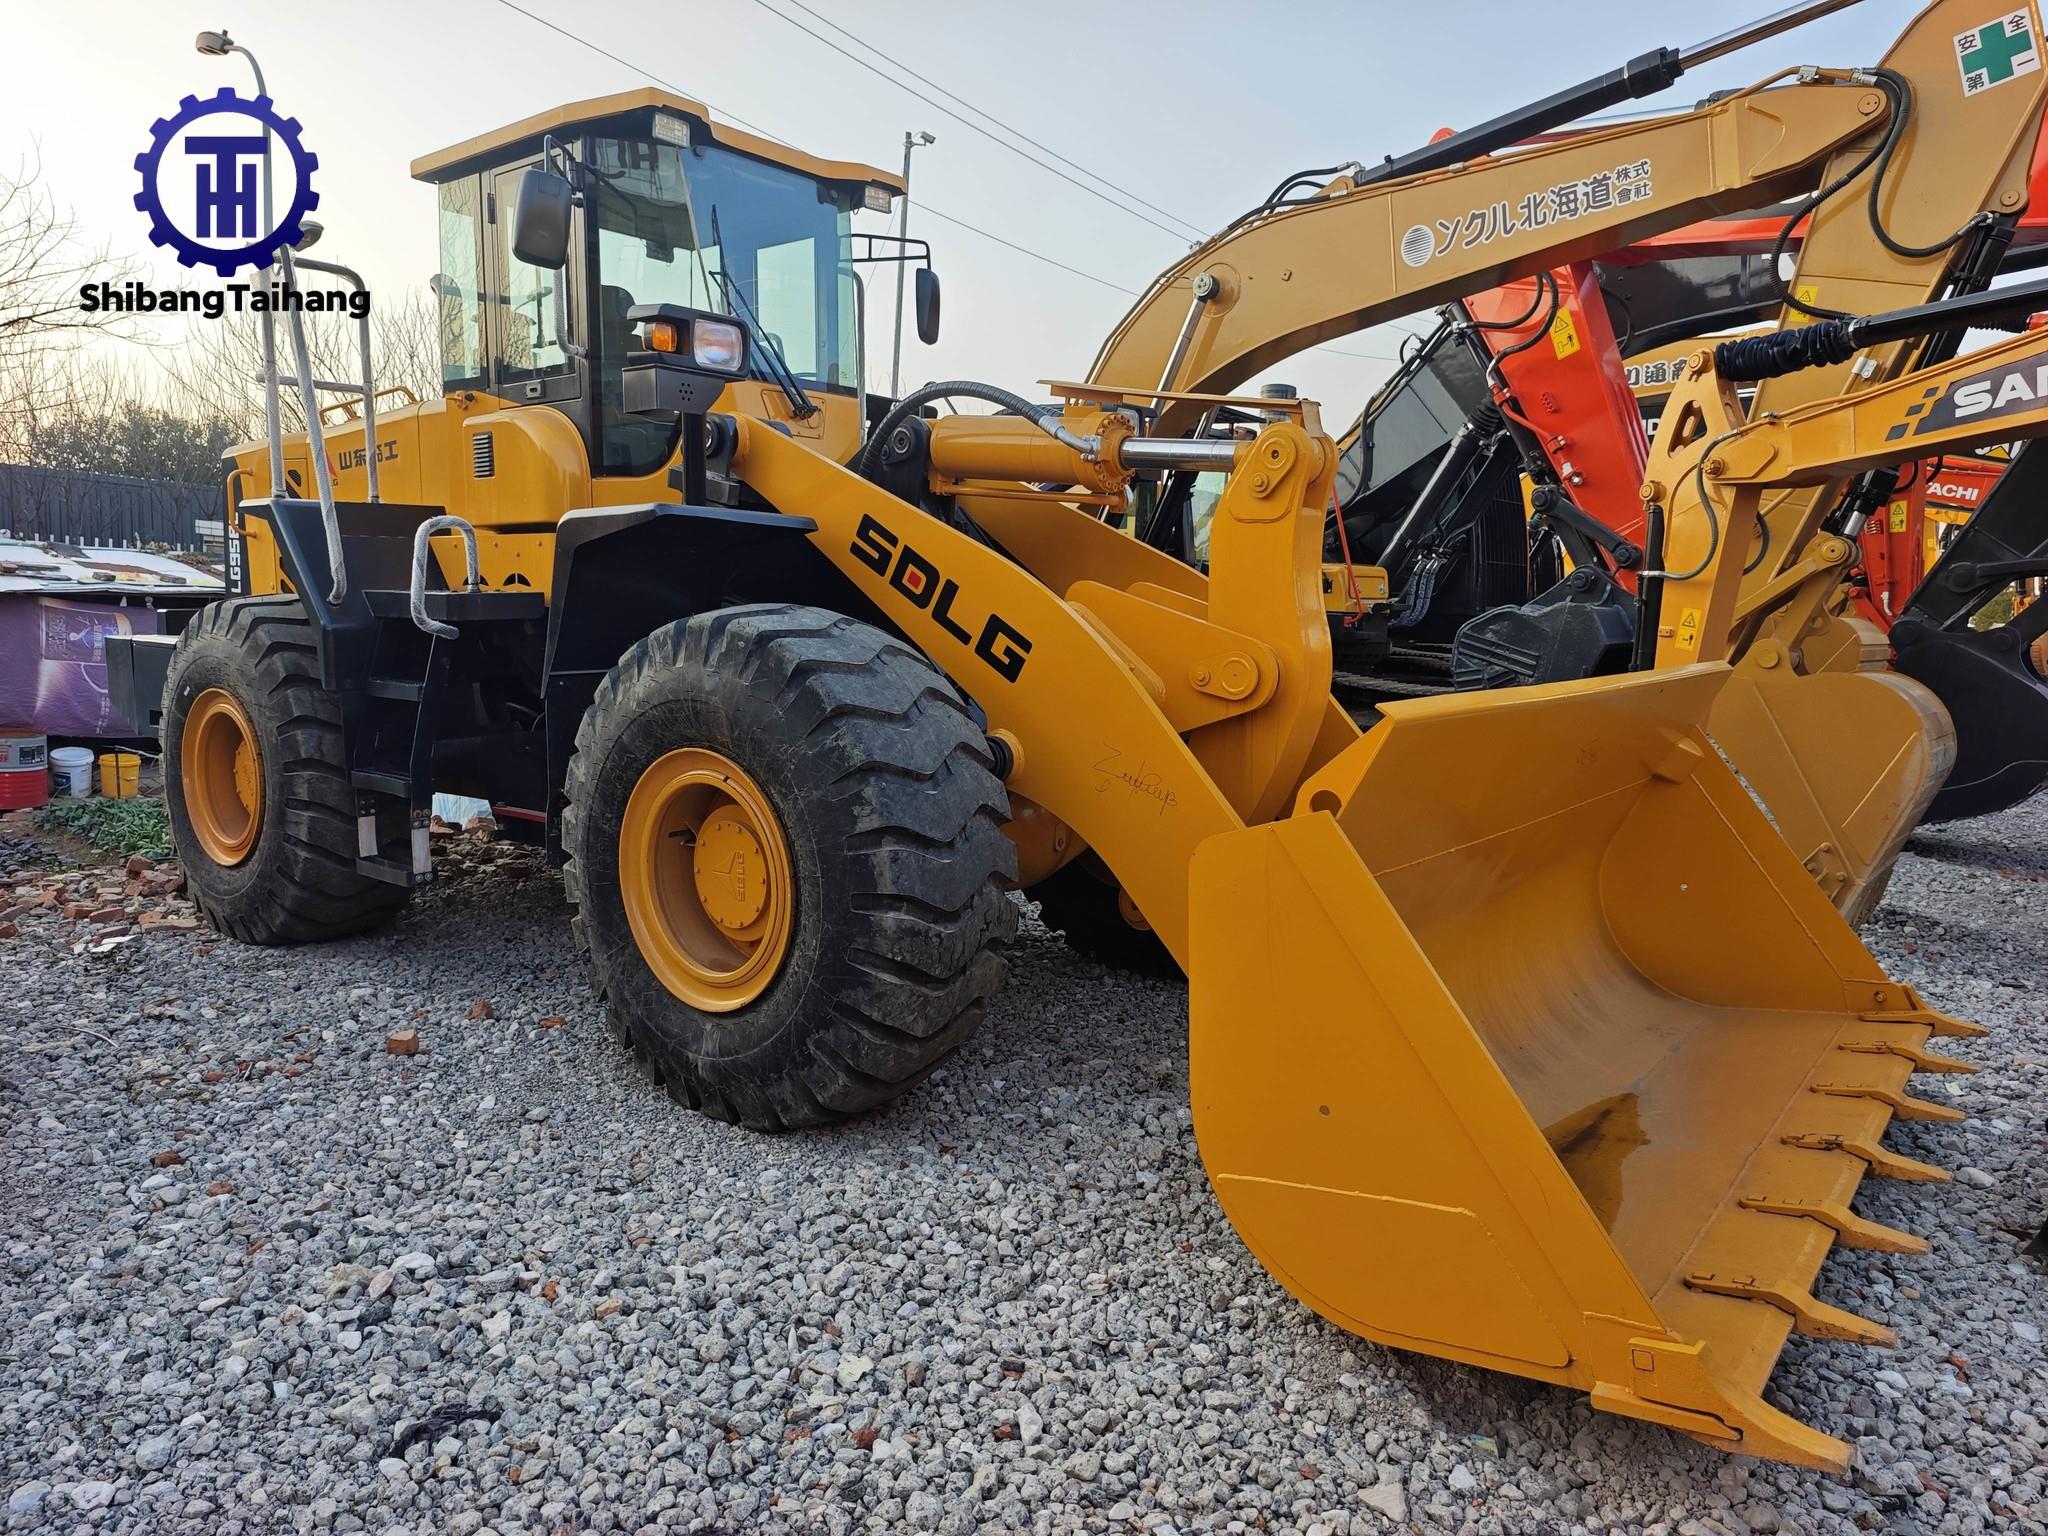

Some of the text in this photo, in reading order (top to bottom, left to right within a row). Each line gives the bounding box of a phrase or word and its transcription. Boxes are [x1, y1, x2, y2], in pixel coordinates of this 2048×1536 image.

[1957, 14, 2027, 54] 安 全
[1615, 160, 1651, 183] 株式
[1926, 482, 1979, 501] ACHI
[849, 512, 1033, 684] SDLG
